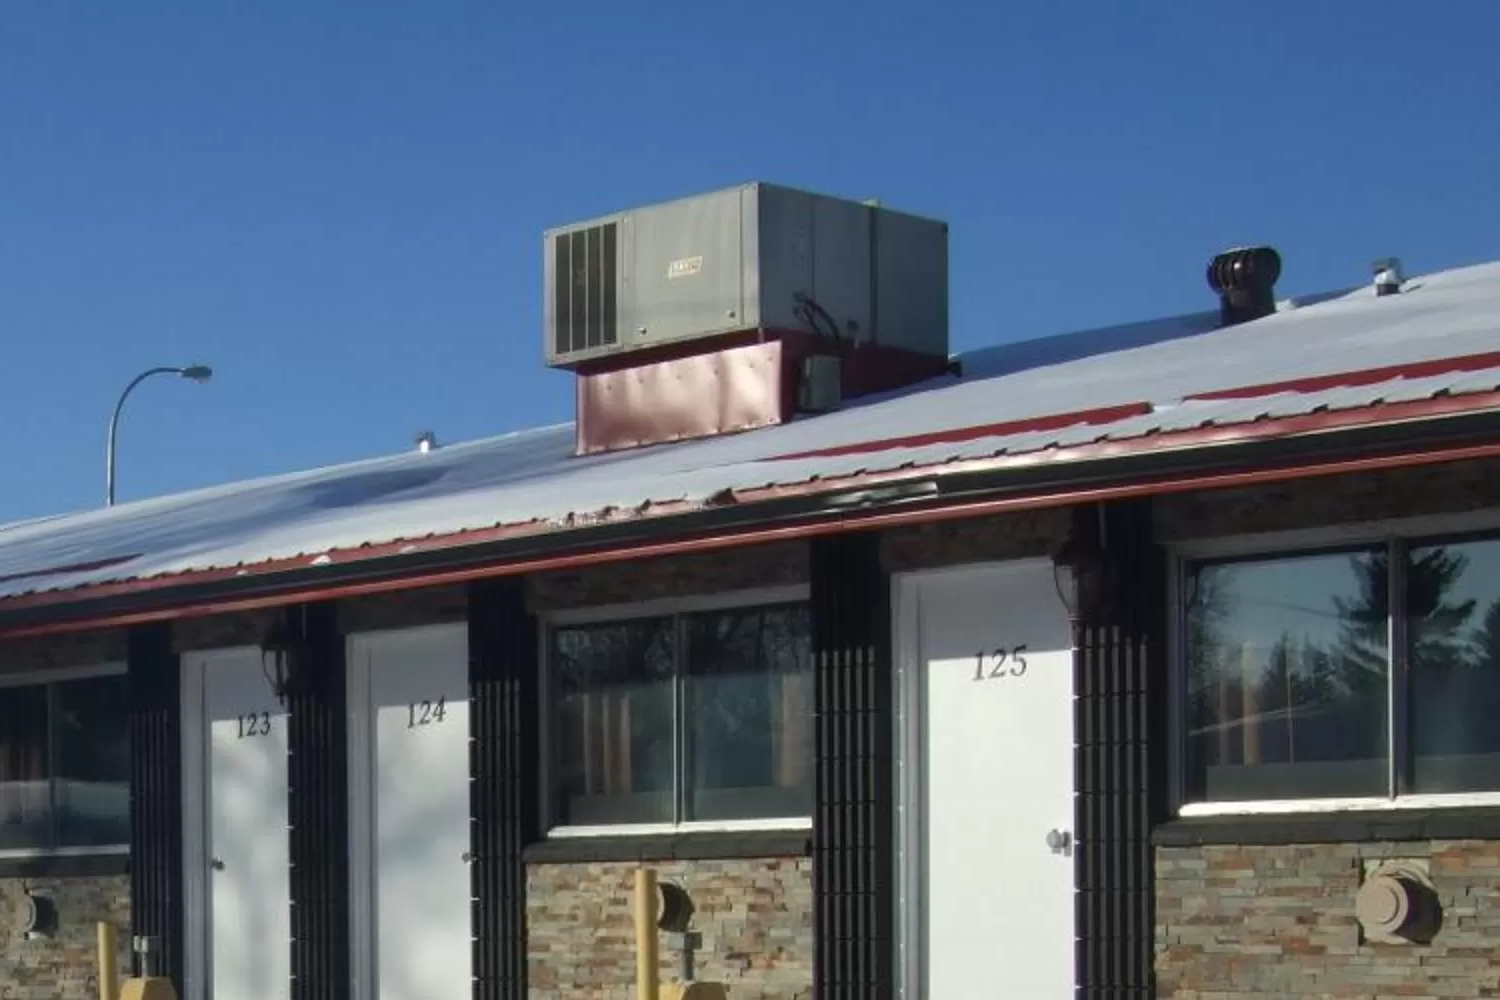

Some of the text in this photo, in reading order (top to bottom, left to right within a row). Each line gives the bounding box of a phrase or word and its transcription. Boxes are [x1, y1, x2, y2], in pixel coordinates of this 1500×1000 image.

[973, 643, 1027, 681] 125
[237, 711, 271, 738] 123
[407, 695, 446, 728] 124
